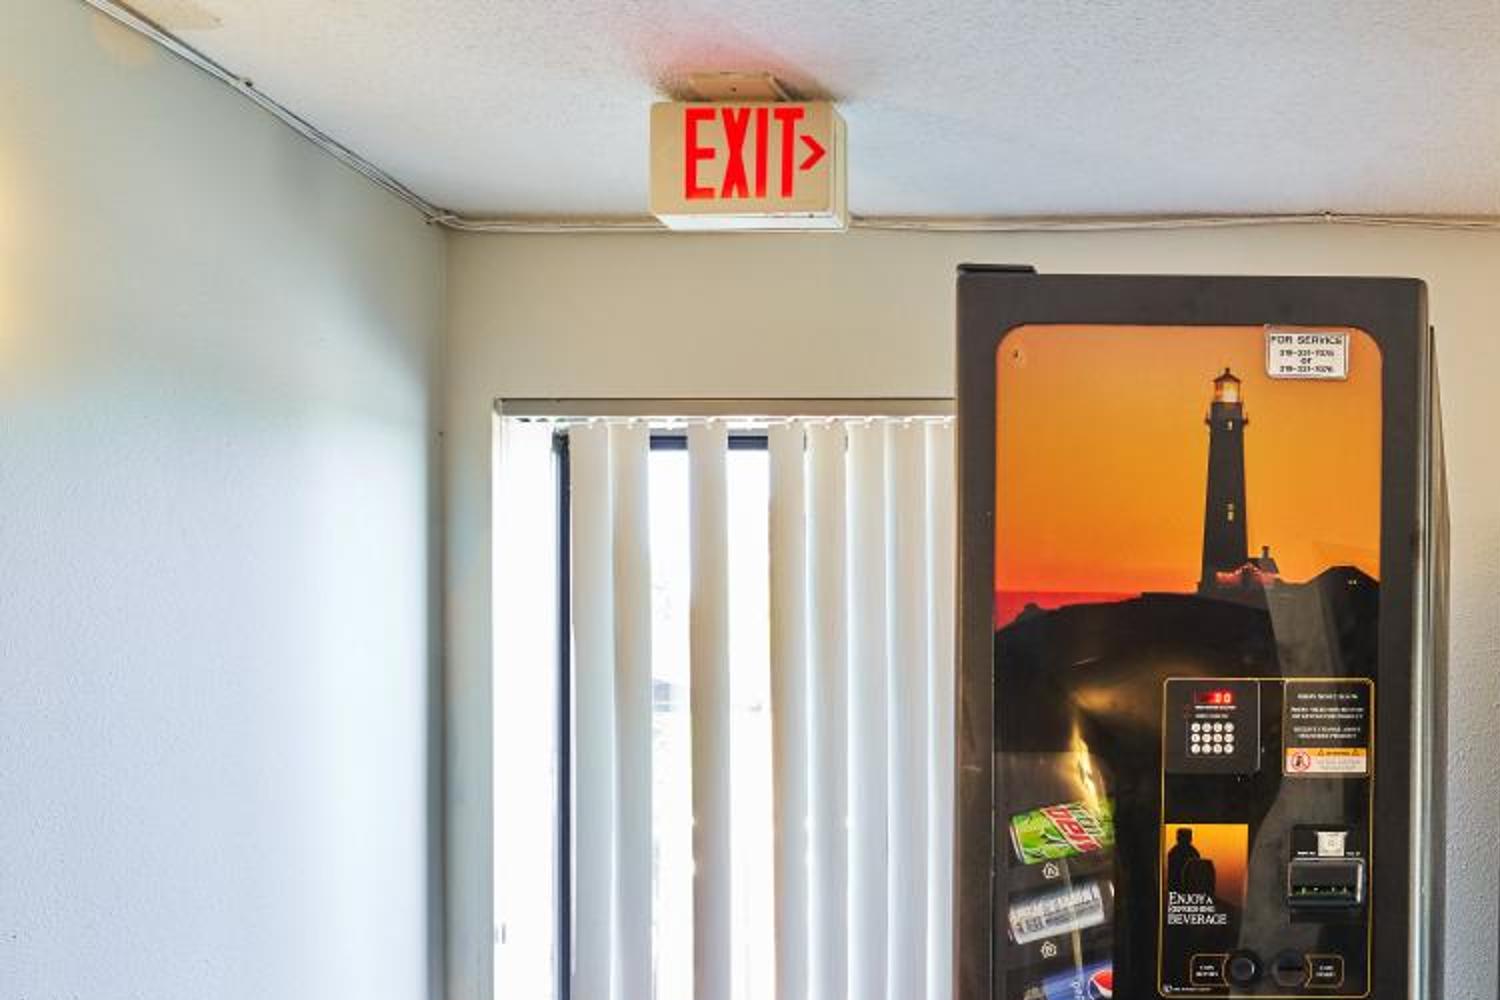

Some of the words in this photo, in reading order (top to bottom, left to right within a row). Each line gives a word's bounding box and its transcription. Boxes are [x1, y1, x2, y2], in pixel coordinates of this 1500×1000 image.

[684, 106, 805, 200] EXIT
[1271, 335, 1293, 345] FOR
[1297, 335, 1343, 345] SERVICE
[1168, 891, 1205, 905] ENJOY
[1168, 913, 1228, 925] BEVERAGE
